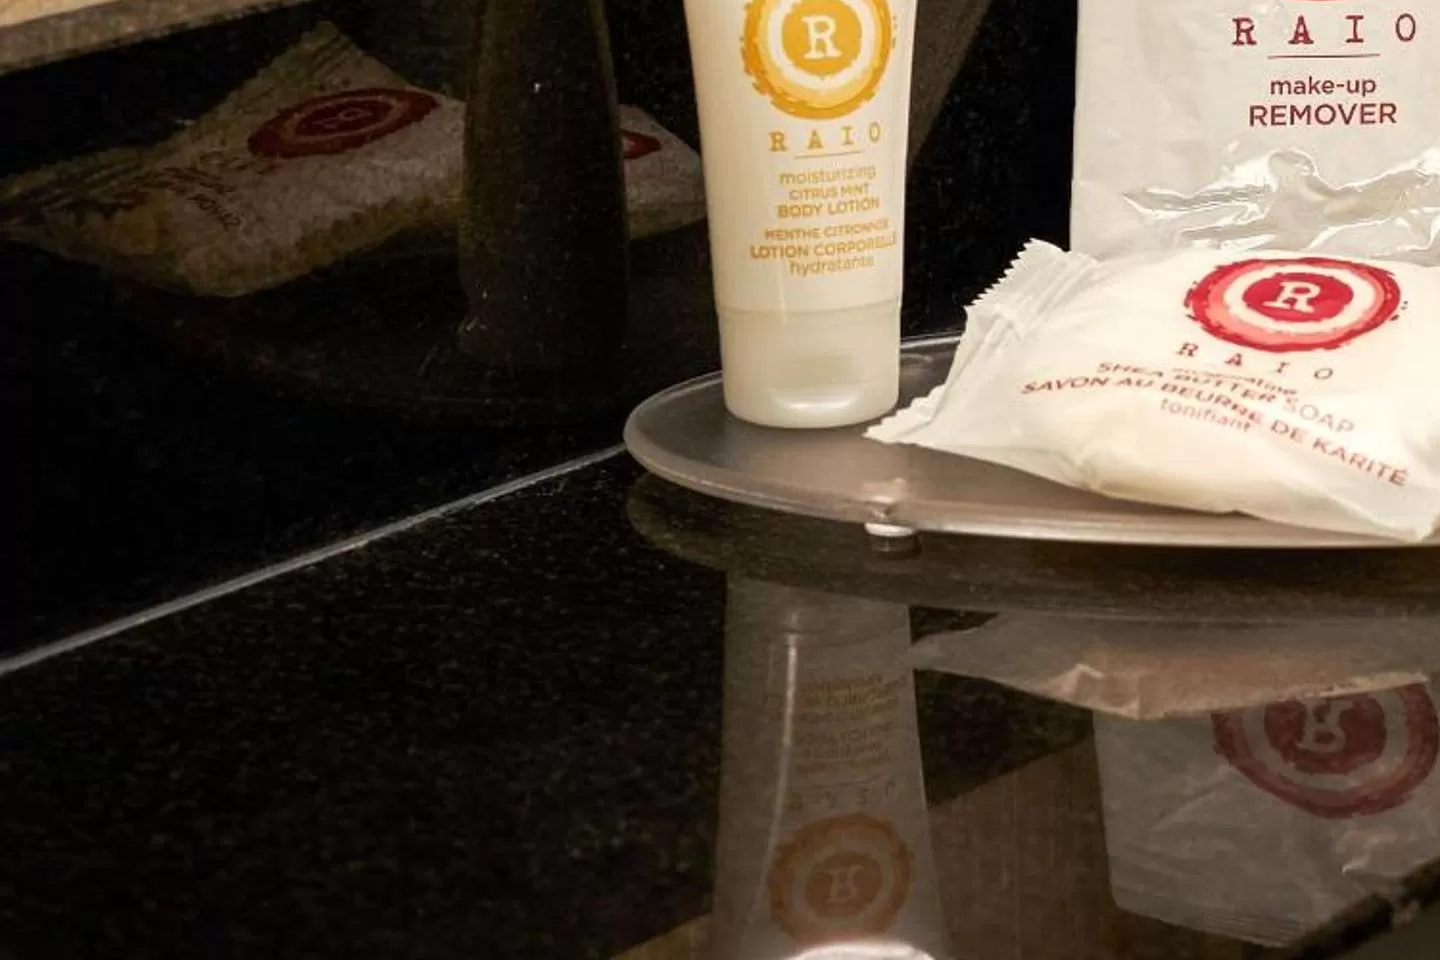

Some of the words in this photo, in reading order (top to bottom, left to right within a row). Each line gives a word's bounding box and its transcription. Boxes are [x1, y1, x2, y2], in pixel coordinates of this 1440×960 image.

[802, 15, 842, 60] R
[1231, 13, 1418, 46] RAIO
[1270, 74, 1377, 99] make-up
[1248, 103, 1398, 127] REMOVER
[768, 121, 882, 153] RAIO
[778, 164, 878, 186] moisturizing
[777, 203, 823, 219] BODY
[827, 197, 881, 216] LOTION
[788, 187, 838, 201] CITRUS
[840, 183, 870, 196] MINT
[764, 227, 821, 241] MENTHE
[750, 243, 810, 259] LOTION
[1261, 280, 1322, 314] R
[1176, 342, 1335, 381] RAIO
[1160, 396, 1253, 433] tonifiant
[1283, 395, 1355, 434] SOAP
[1020, 375, 1110, 395] SAVON
[1115, 376, 1156, 388] AU
[1270, 419, 1308, 444] DE
[1312, 436, 1411, 488] KARITÉ
